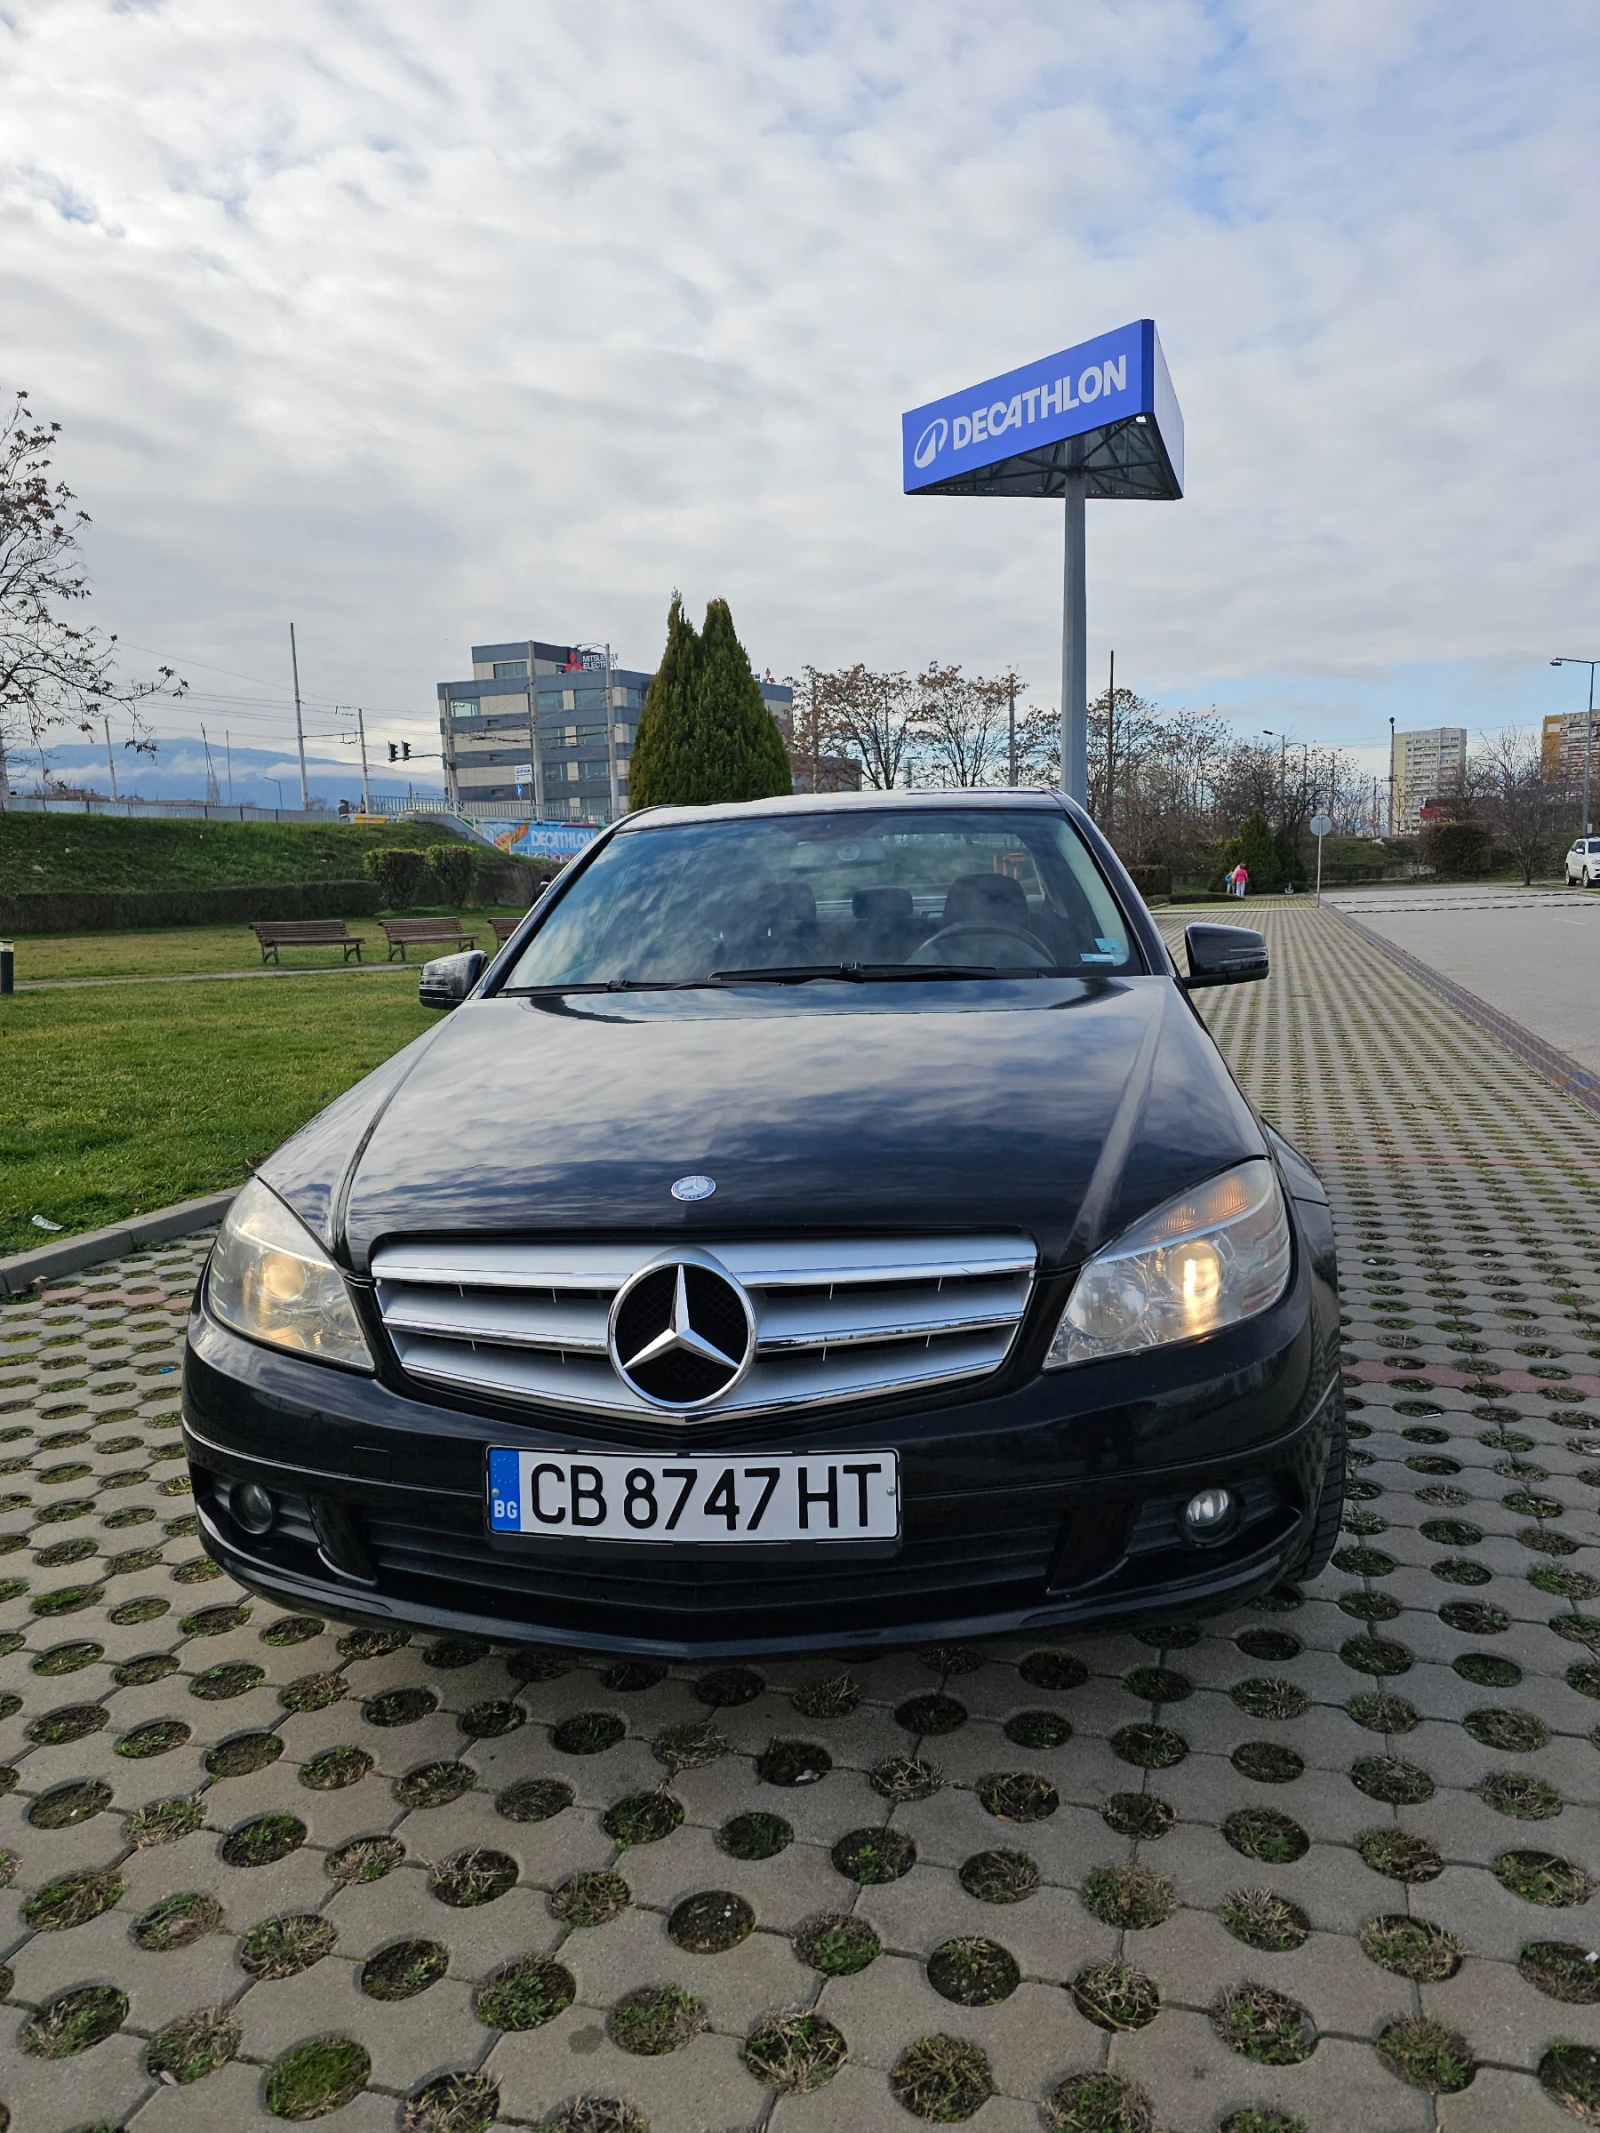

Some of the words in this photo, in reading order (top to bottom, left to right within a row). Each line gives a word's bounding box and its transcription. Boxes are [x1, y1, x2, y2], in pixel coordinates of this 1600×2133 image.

[952, 354, 1126, 450] DECATHLON
[530, 830, 596, 849] DECATHLON
[494, 1499, 518, 1519] BG
[531, 1463, 607, 1526] CB
[623, 1467, 780, 1531] 8747
[798, 1464, 882, 1528] HT
